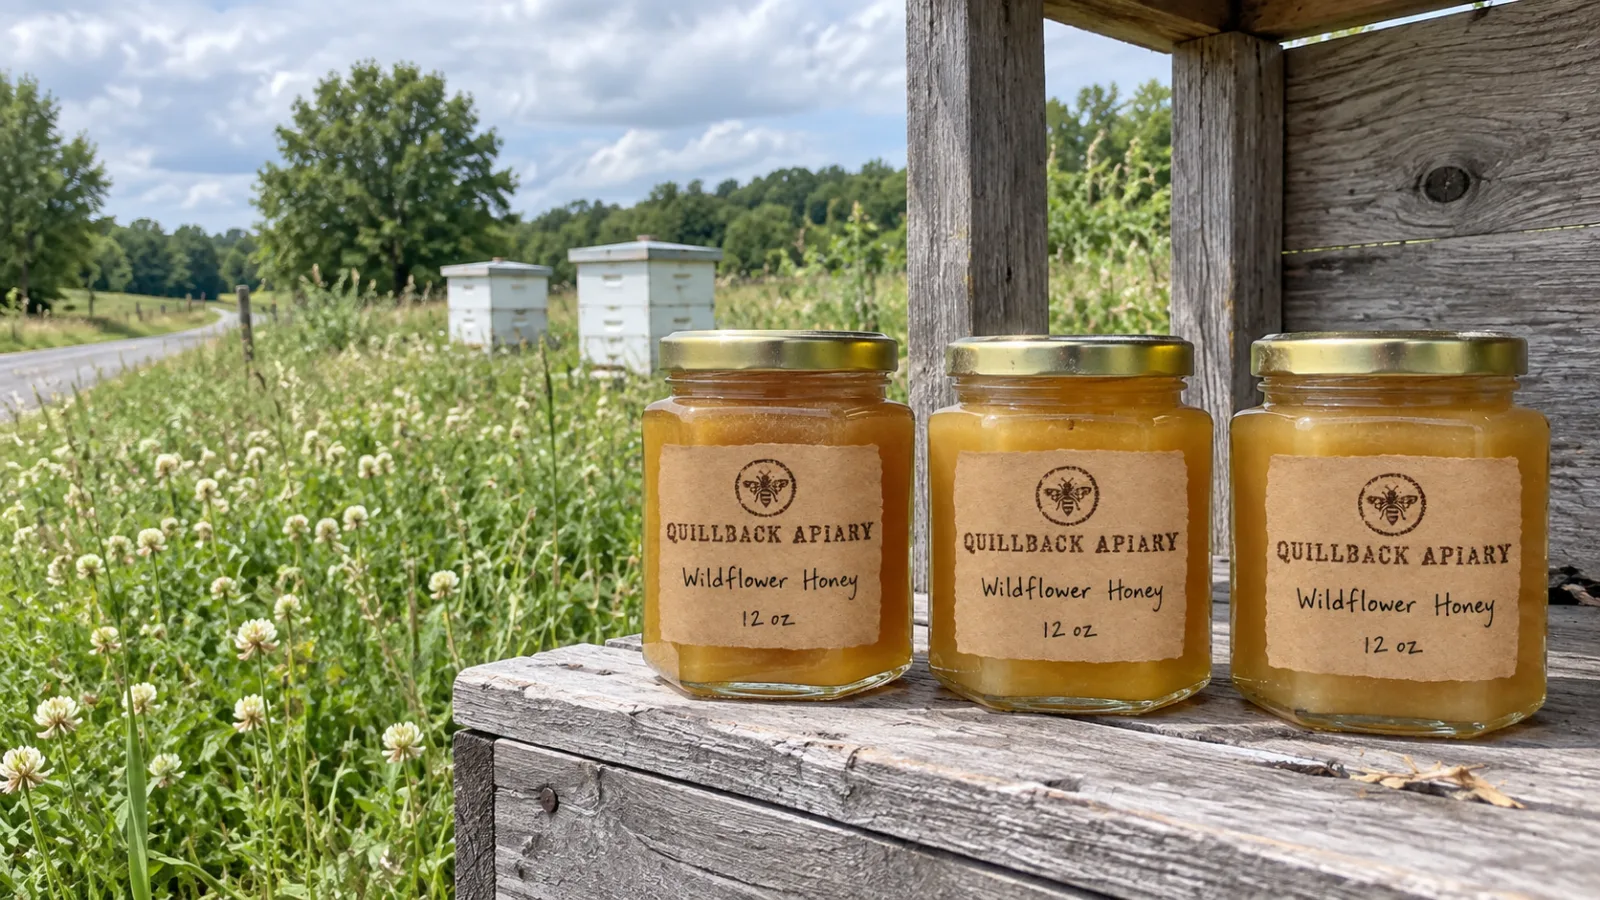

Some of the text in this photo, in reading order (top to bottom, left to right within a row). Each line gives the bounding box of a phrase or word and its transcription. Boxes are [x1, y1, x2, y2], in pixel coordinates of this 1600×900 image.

[666, 521, 874, 544] QUILLBACK APIARY
[964, 531, 1179, 554] QUILLBACK APIARY
[1276, 540, 1512, 566] QUILLBACK APIARY
[682, 565, 858, 600] Wildflower Honey
[981, 575, 1164, 612] Wildflower Honey
[742, 610, 796, 626] 12 oz
[1296, 587, 1495, 628] Wildflower Honey
[1044, 621, 1098, 638] 12 oz
[1365, 636, 1423, 654] 12 oz
